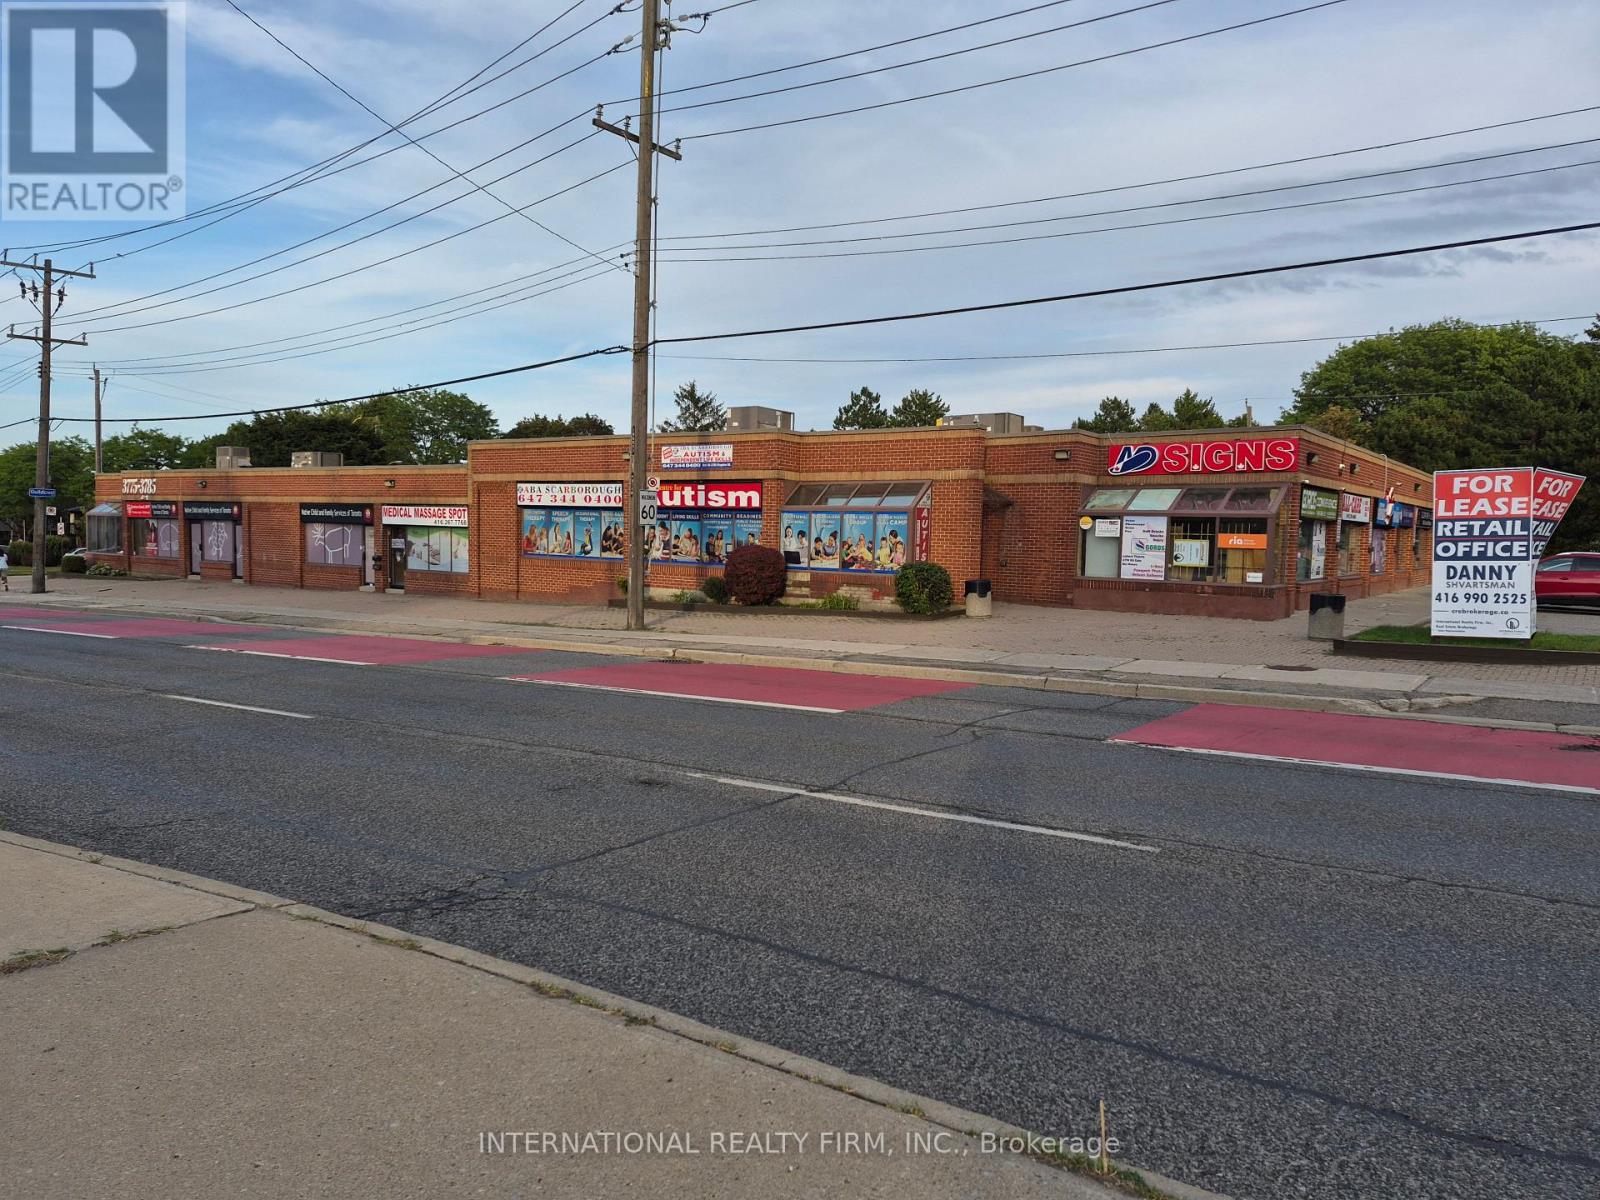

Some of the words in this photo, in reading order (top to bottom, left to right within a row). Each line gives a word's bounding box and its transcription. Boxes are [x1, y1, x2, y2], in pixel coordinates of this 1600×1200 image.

[1162, 440, 1295, 473] SIGNS
[545, 485, 621, 494] SCARBOROUGH
[1452, 475, 1514, 494] FOR
[1537, 476, 1574, 498] FOR
[518, 494, 543, 503] 647
[550, 494, 576, 503] 344
[583, 495, 622, 503] 0400
[1437, 497, 1529, 516] LEASE
[383, 507, 412, 517] MEDICAL
[414, 507, 446, 518] MASSAGE
[448, 508, 467, 519] SPOT
[641, 504, 656, 520] 60
[1532, 498, 1569, 518] EASE
[1437, 520, 1528, 536] RETAIL
[1531, 520, 1555, 536] TAIL
[1436, 541, 1528, 557] OFFICE
[1446, 565, 1517, 580] DANNY
[1446, 581, 1515, 589] SHVARTSMAN
[1435, 592, 1459, 603] 416
[1464, 592, 1488, 603] 990
[1493, 593, 1527, 604] 2525
